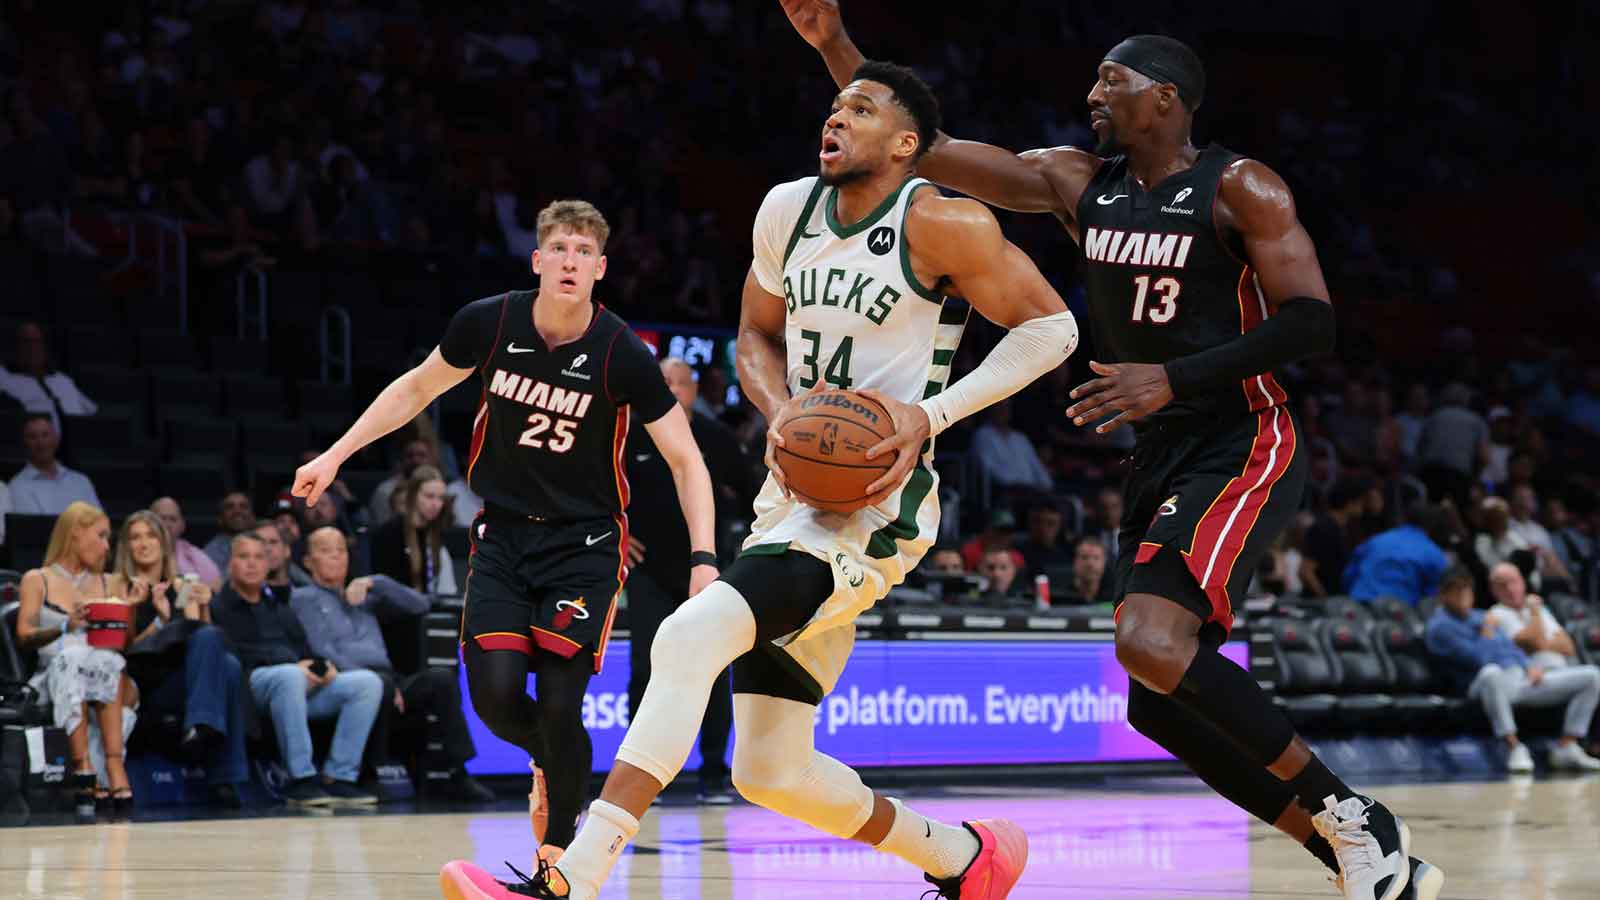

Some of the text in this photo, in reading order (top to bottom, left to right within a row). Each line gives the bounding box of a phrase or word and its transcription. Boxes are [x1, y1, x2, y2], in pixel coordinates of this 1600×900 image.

[1160, 206, 1194, 215] Robinhood
[1085, 227, 1193, 268] MIAMI
[783, 268, 901, 326] BUCKS
[1131, 275, 1181, 323] 13
[799, 329, 854, 390] 34
[489, 368, 593, 418] MIAMI
[518, 412, 578, 453] 25
[827, 685, 978, 735] platform.
